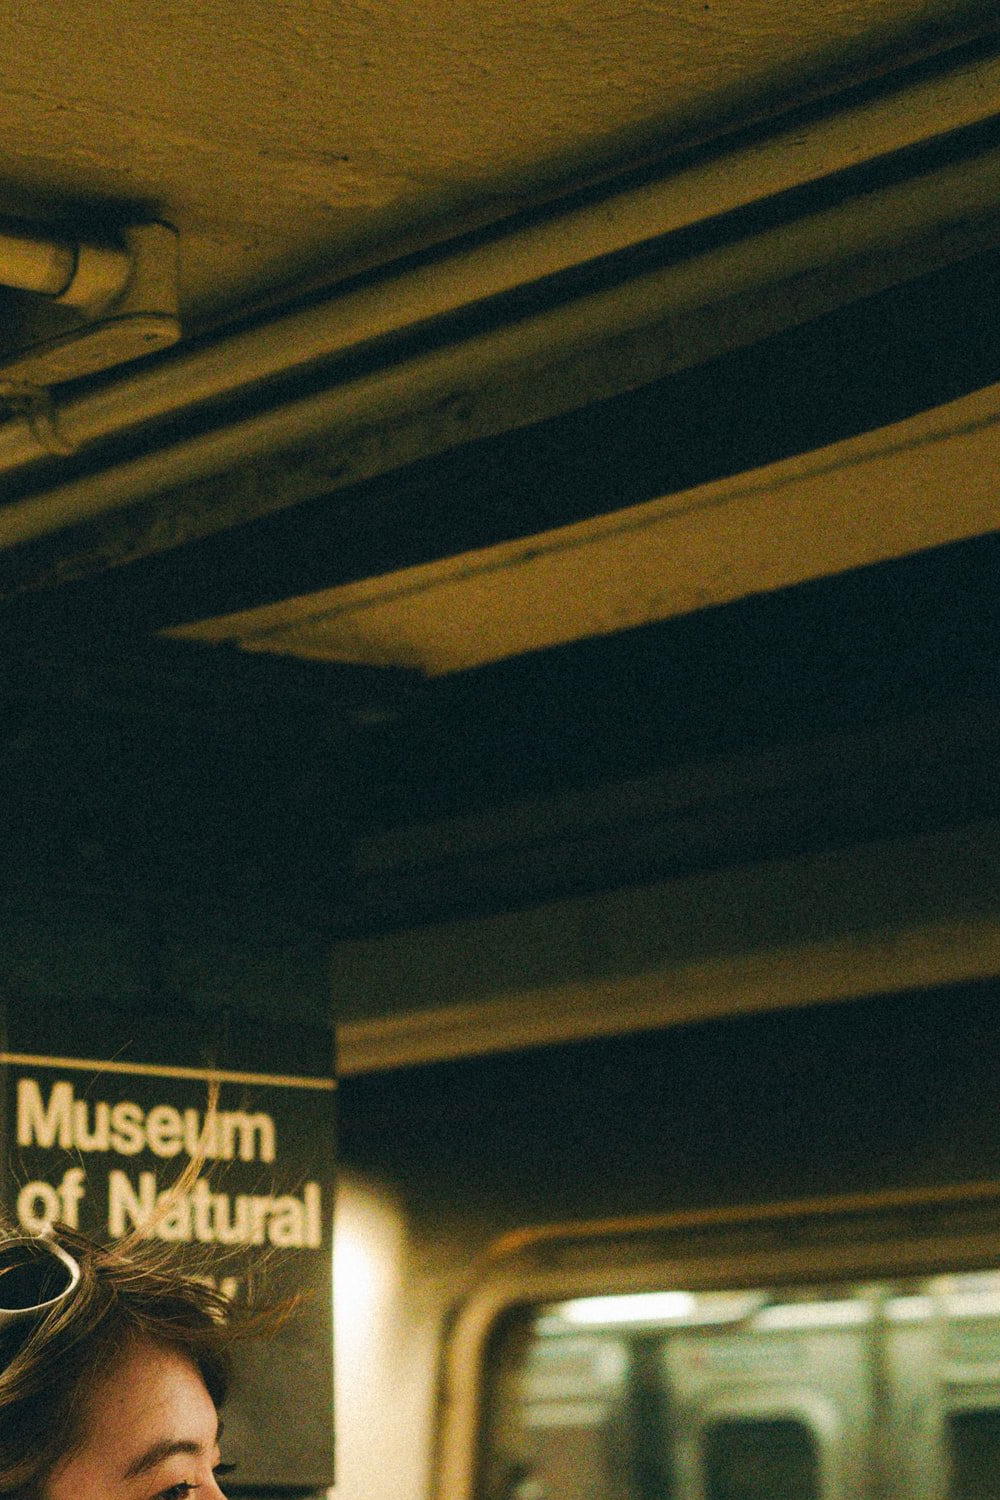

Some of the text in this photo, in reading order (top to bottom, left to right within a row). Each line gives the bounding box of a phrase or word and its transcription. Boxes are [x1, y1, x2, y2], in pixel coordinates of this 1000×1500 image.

[17, 1078, 275, 1163] Museum
[17, 1167, 322, 1250] of Natural
